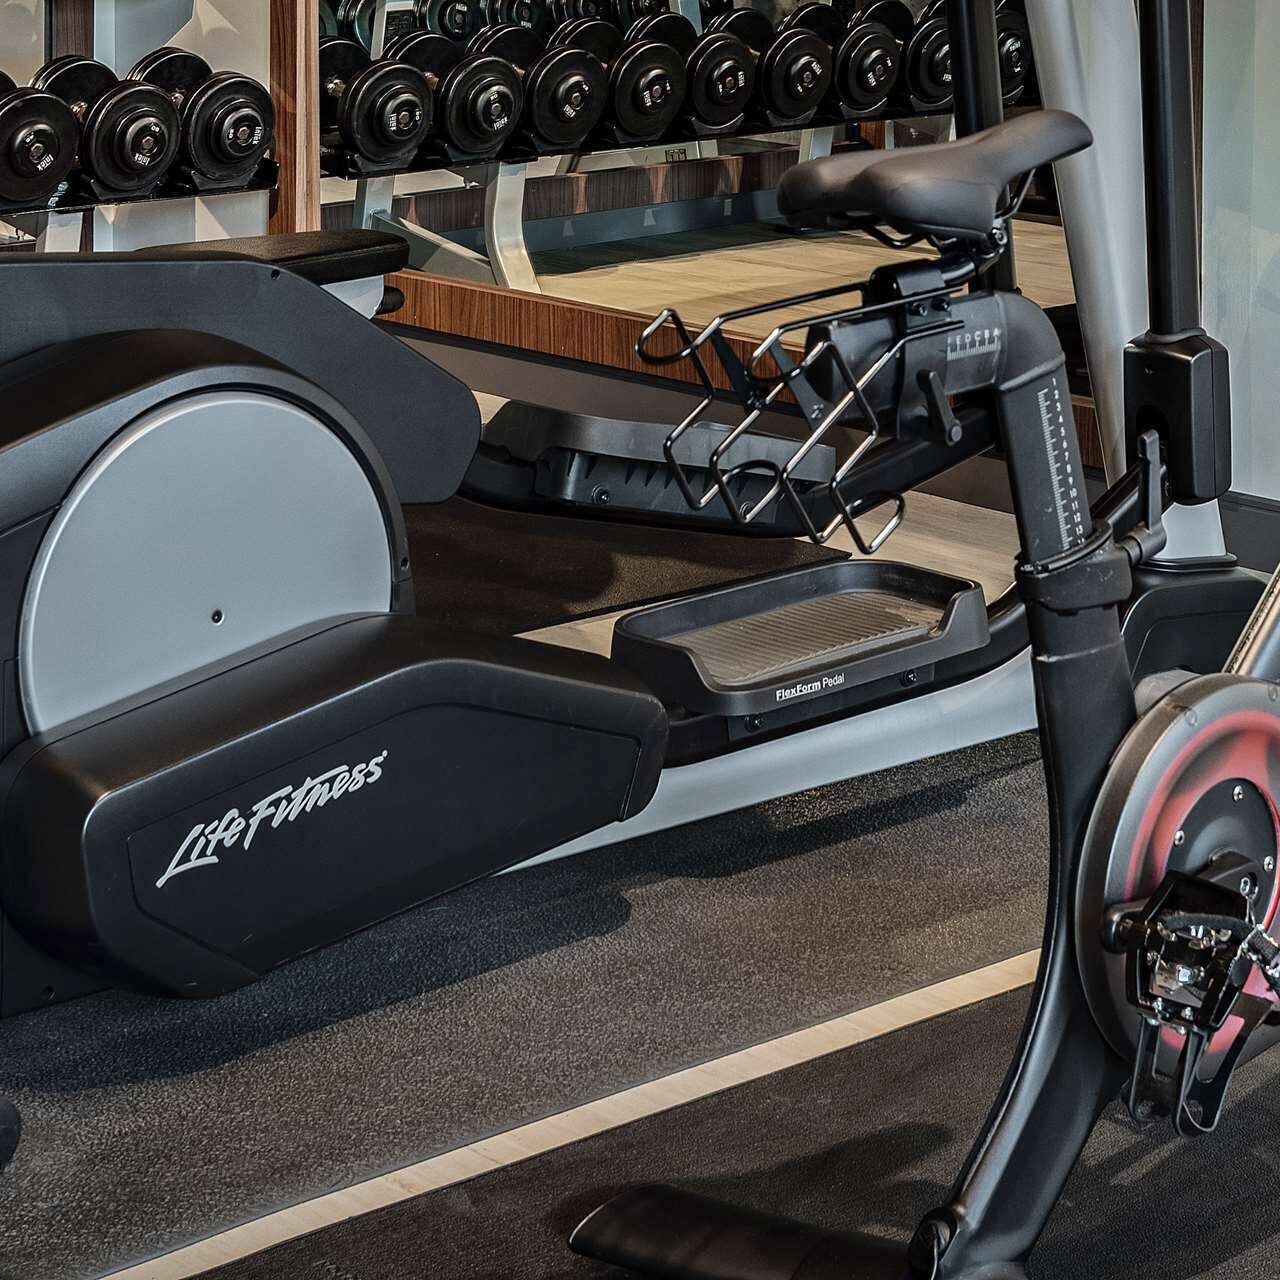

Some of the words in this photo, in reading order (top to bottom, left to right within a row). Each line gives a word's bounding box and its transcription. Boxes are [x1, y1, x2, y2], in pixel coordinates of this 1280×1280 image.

[776, 681, 821, 702] FlexForm
[822, 672, 845, 688] Pedal
[155, 807, 245, 888] Life
[242, 754, 385, 851] Fitness
